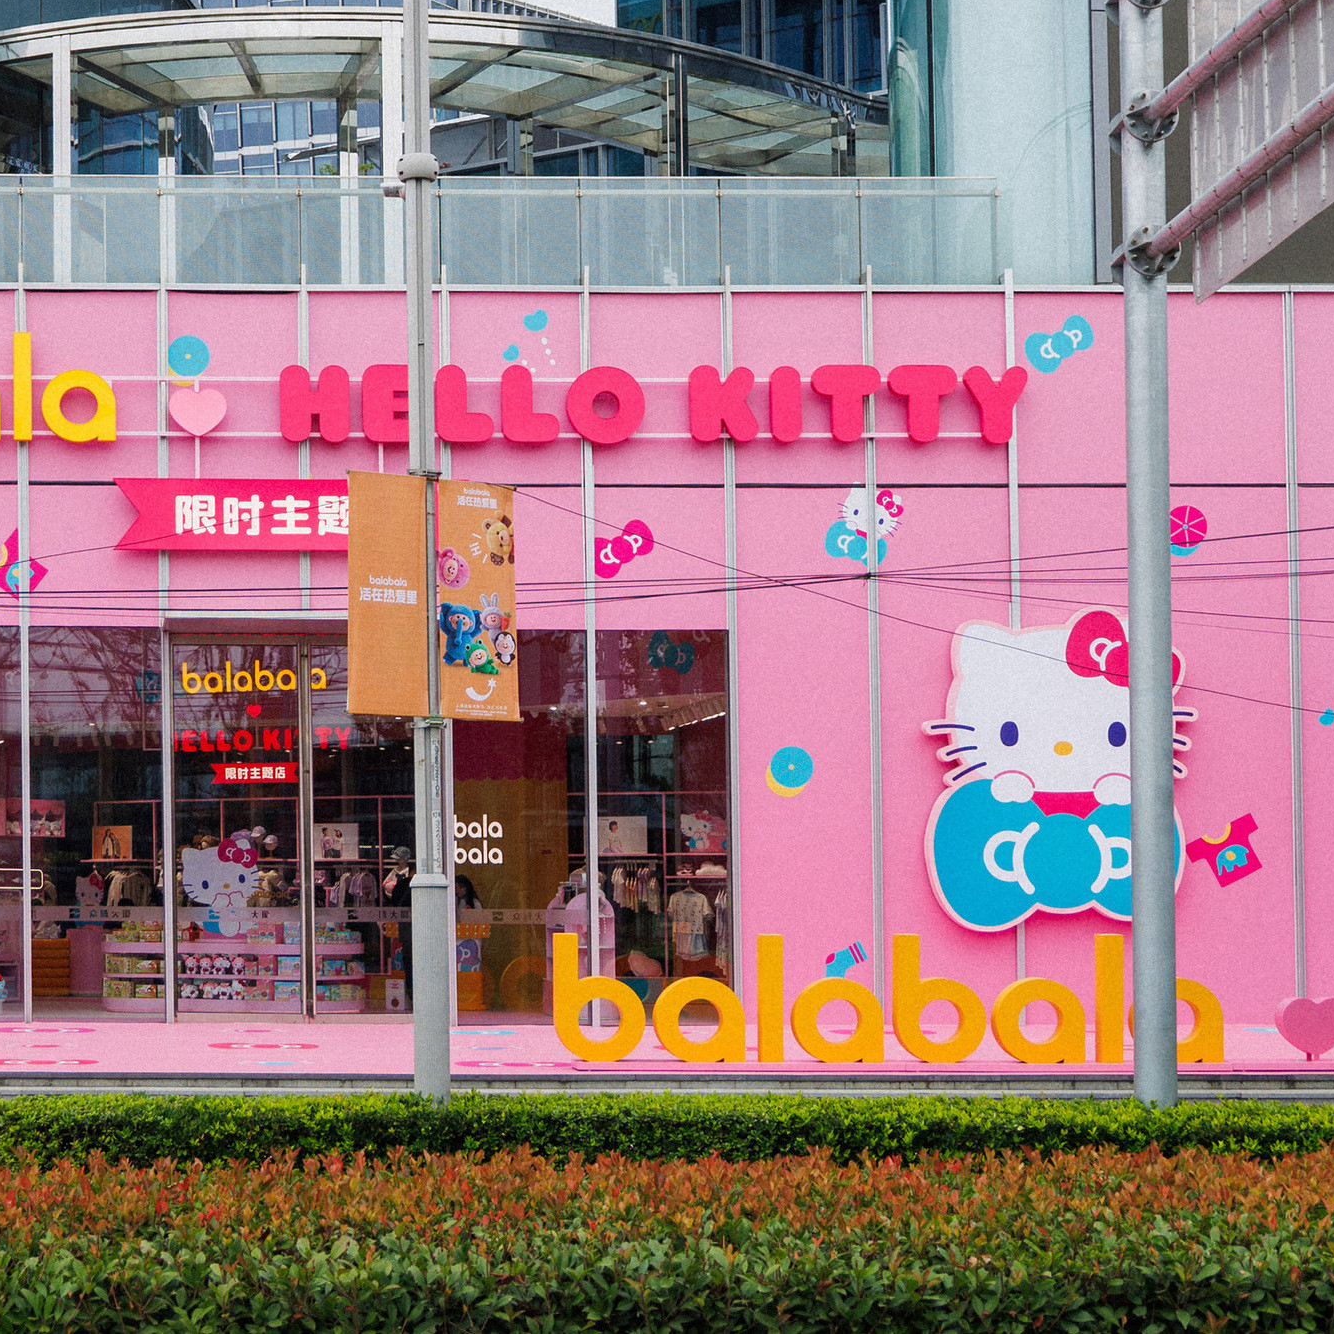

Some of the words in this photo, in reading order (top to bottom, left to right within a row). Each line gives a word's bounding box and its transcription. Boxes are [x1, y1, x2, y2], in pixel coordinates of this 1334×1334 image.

[279, 363, 646, 445] HELLO
[687, 364, 1028, 445] KITTY
[175, 494, 348, 537] 限时主题
[469, 541, 482, 556] Hi
[369, 574, 408, 587] balabala
[359, 587, 418, 605] 活在热爱里
[182, 659, 327, 694] balabaa
[262, 726, 352, 752] KITY
[224, 766, 286, 781] 限时主题店
[454, 813, 504, 839] bala
[454, 839, 504, 865] bala
[553, 932, 1224, 1064] balabala
